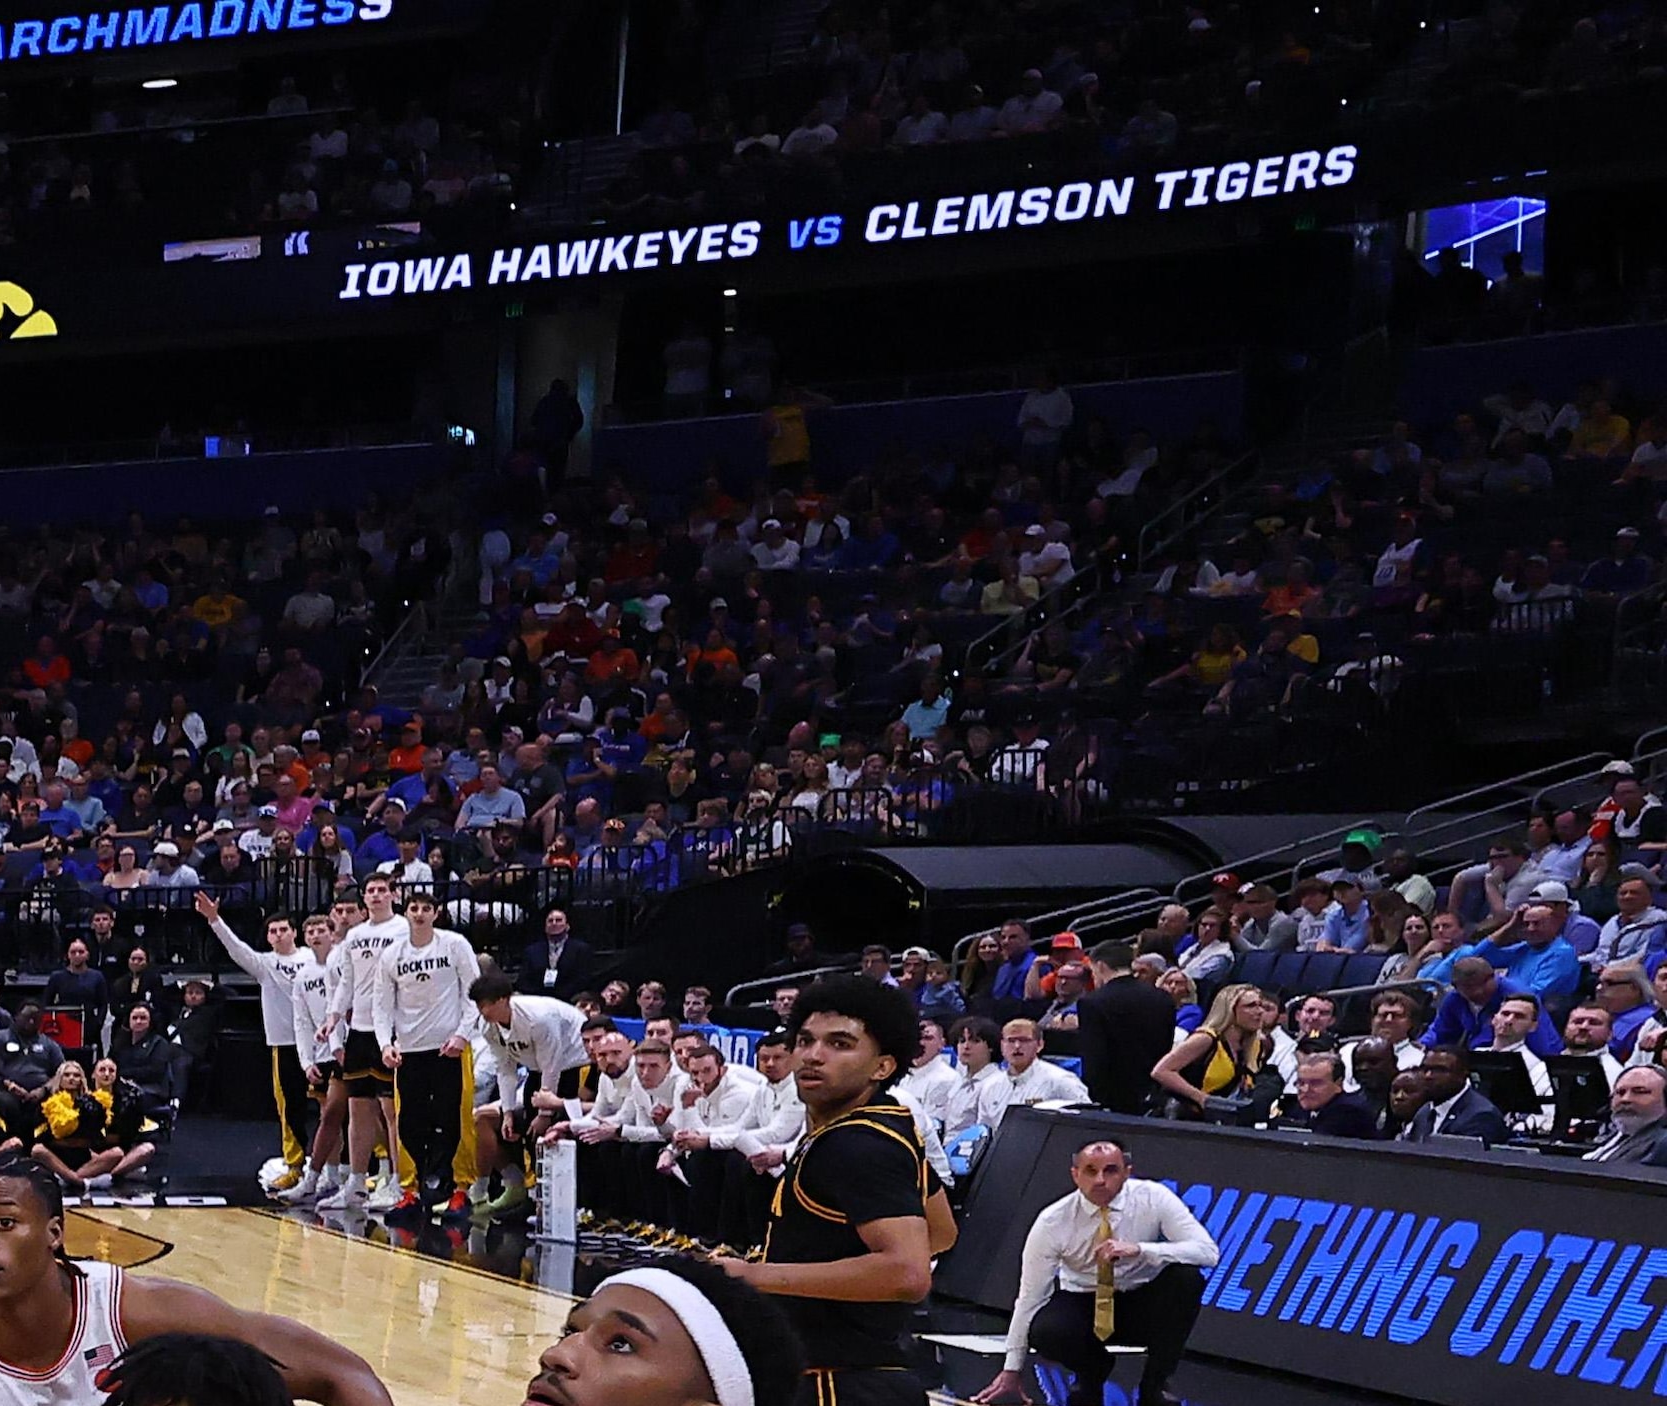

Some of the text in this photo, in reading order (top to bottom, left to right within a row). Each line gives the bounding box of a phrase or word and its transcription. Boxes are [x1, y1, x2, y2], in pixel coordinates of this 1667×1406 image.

[339, 145, 1358, 298] IOWA HAWKEYES VS CLEMSON TIGERS
[397, 963, 424, 977] LOCK
